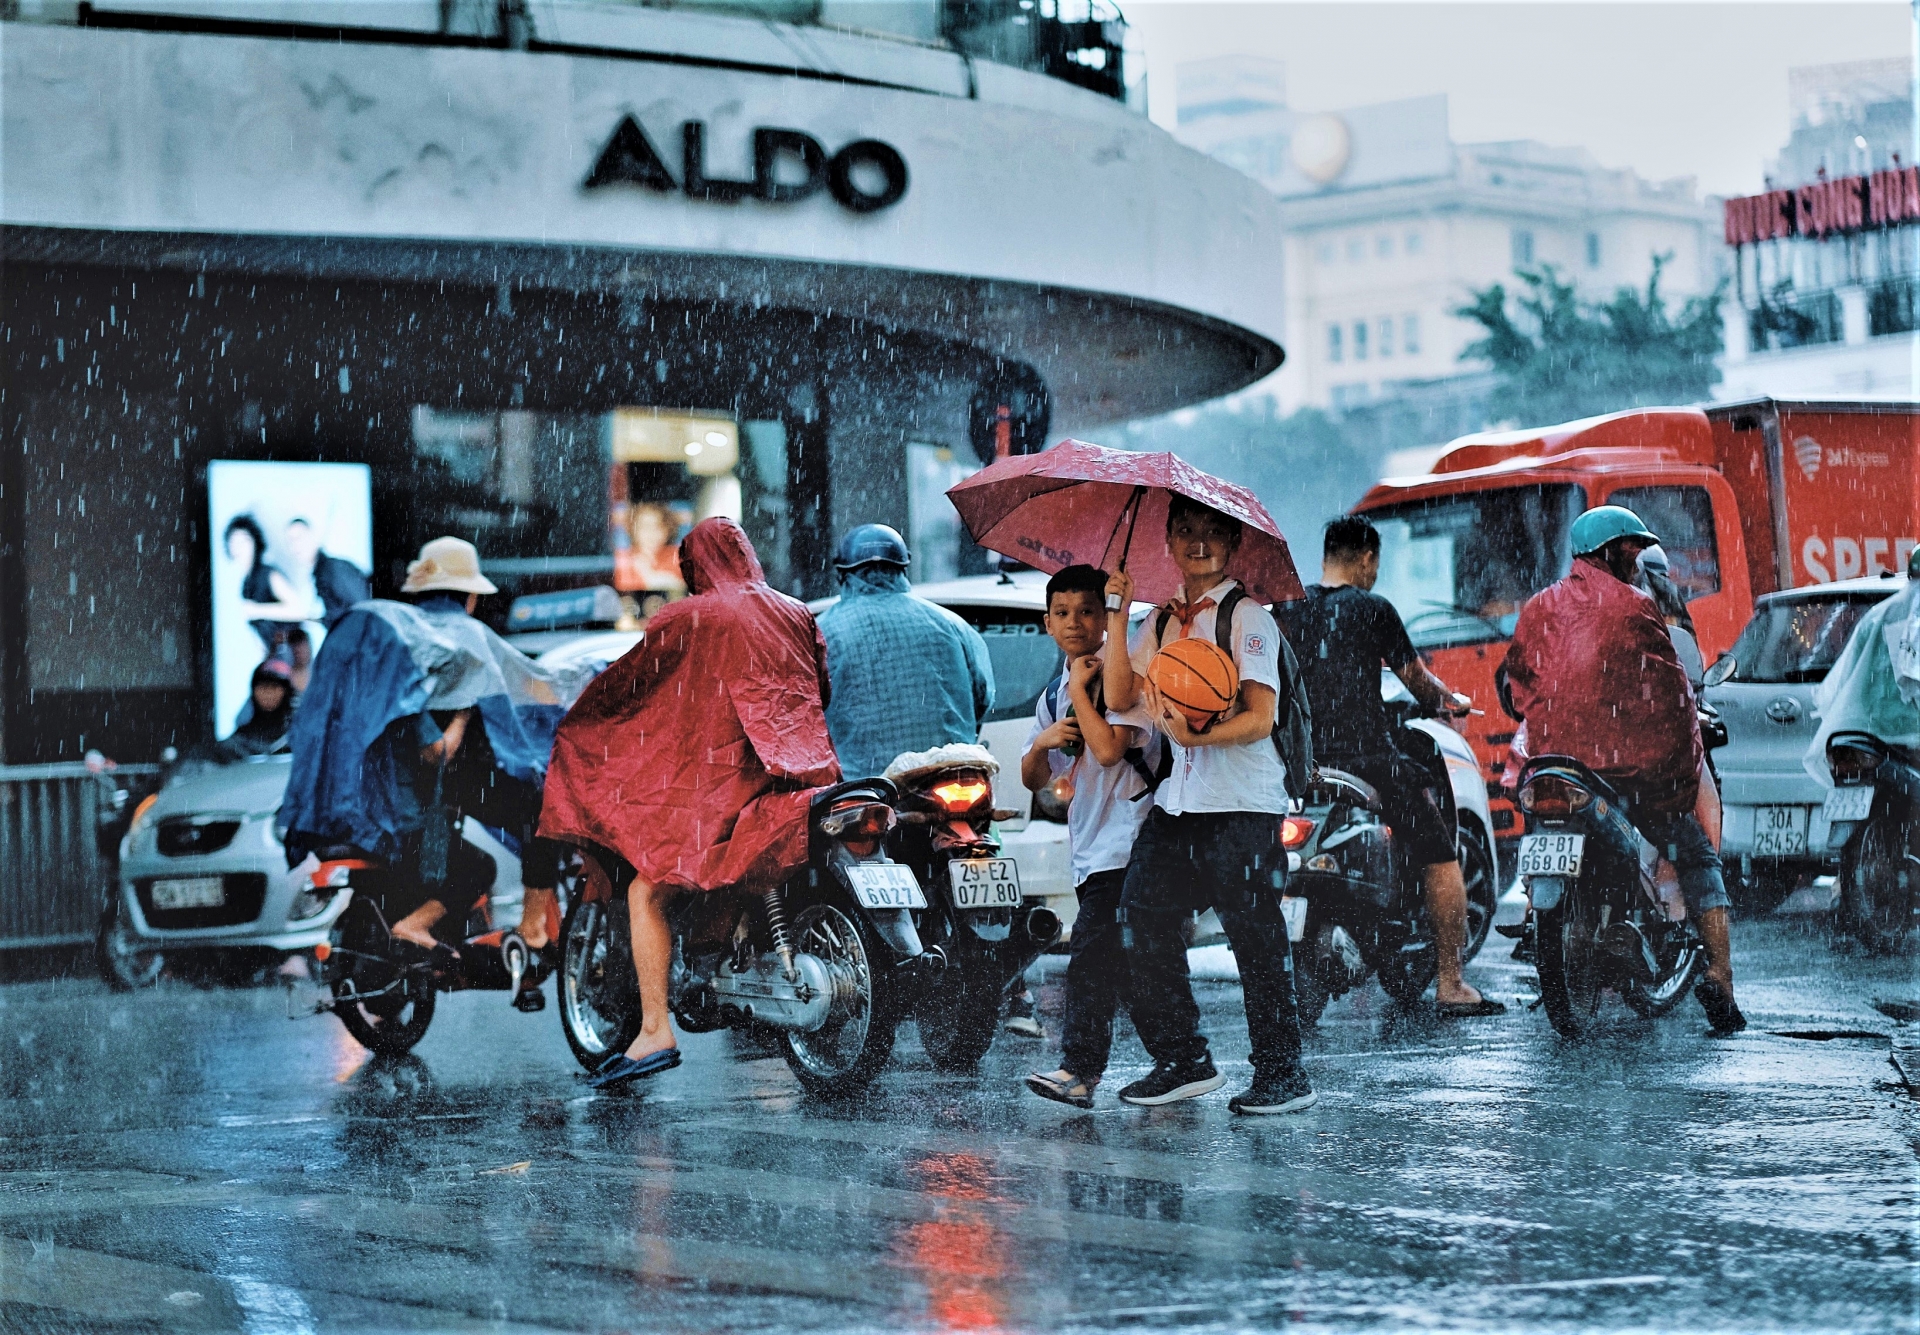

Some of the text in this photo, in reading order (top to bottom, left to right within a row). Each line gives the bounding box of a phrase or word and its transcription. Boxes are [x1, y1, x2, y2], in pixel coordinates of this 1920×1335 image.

[583, 114, 909, 213] ALDO
[1767, 809, 1793, 830] 30A
[1528, 836, 1575, 853] 29-B1
[960, 862, 1010, 882] 29-E2
[1521, 854, 1579, 873] 668.05
[866, 887, 913, 905] 6027
[958, 883, 1017, 905] 077.80
